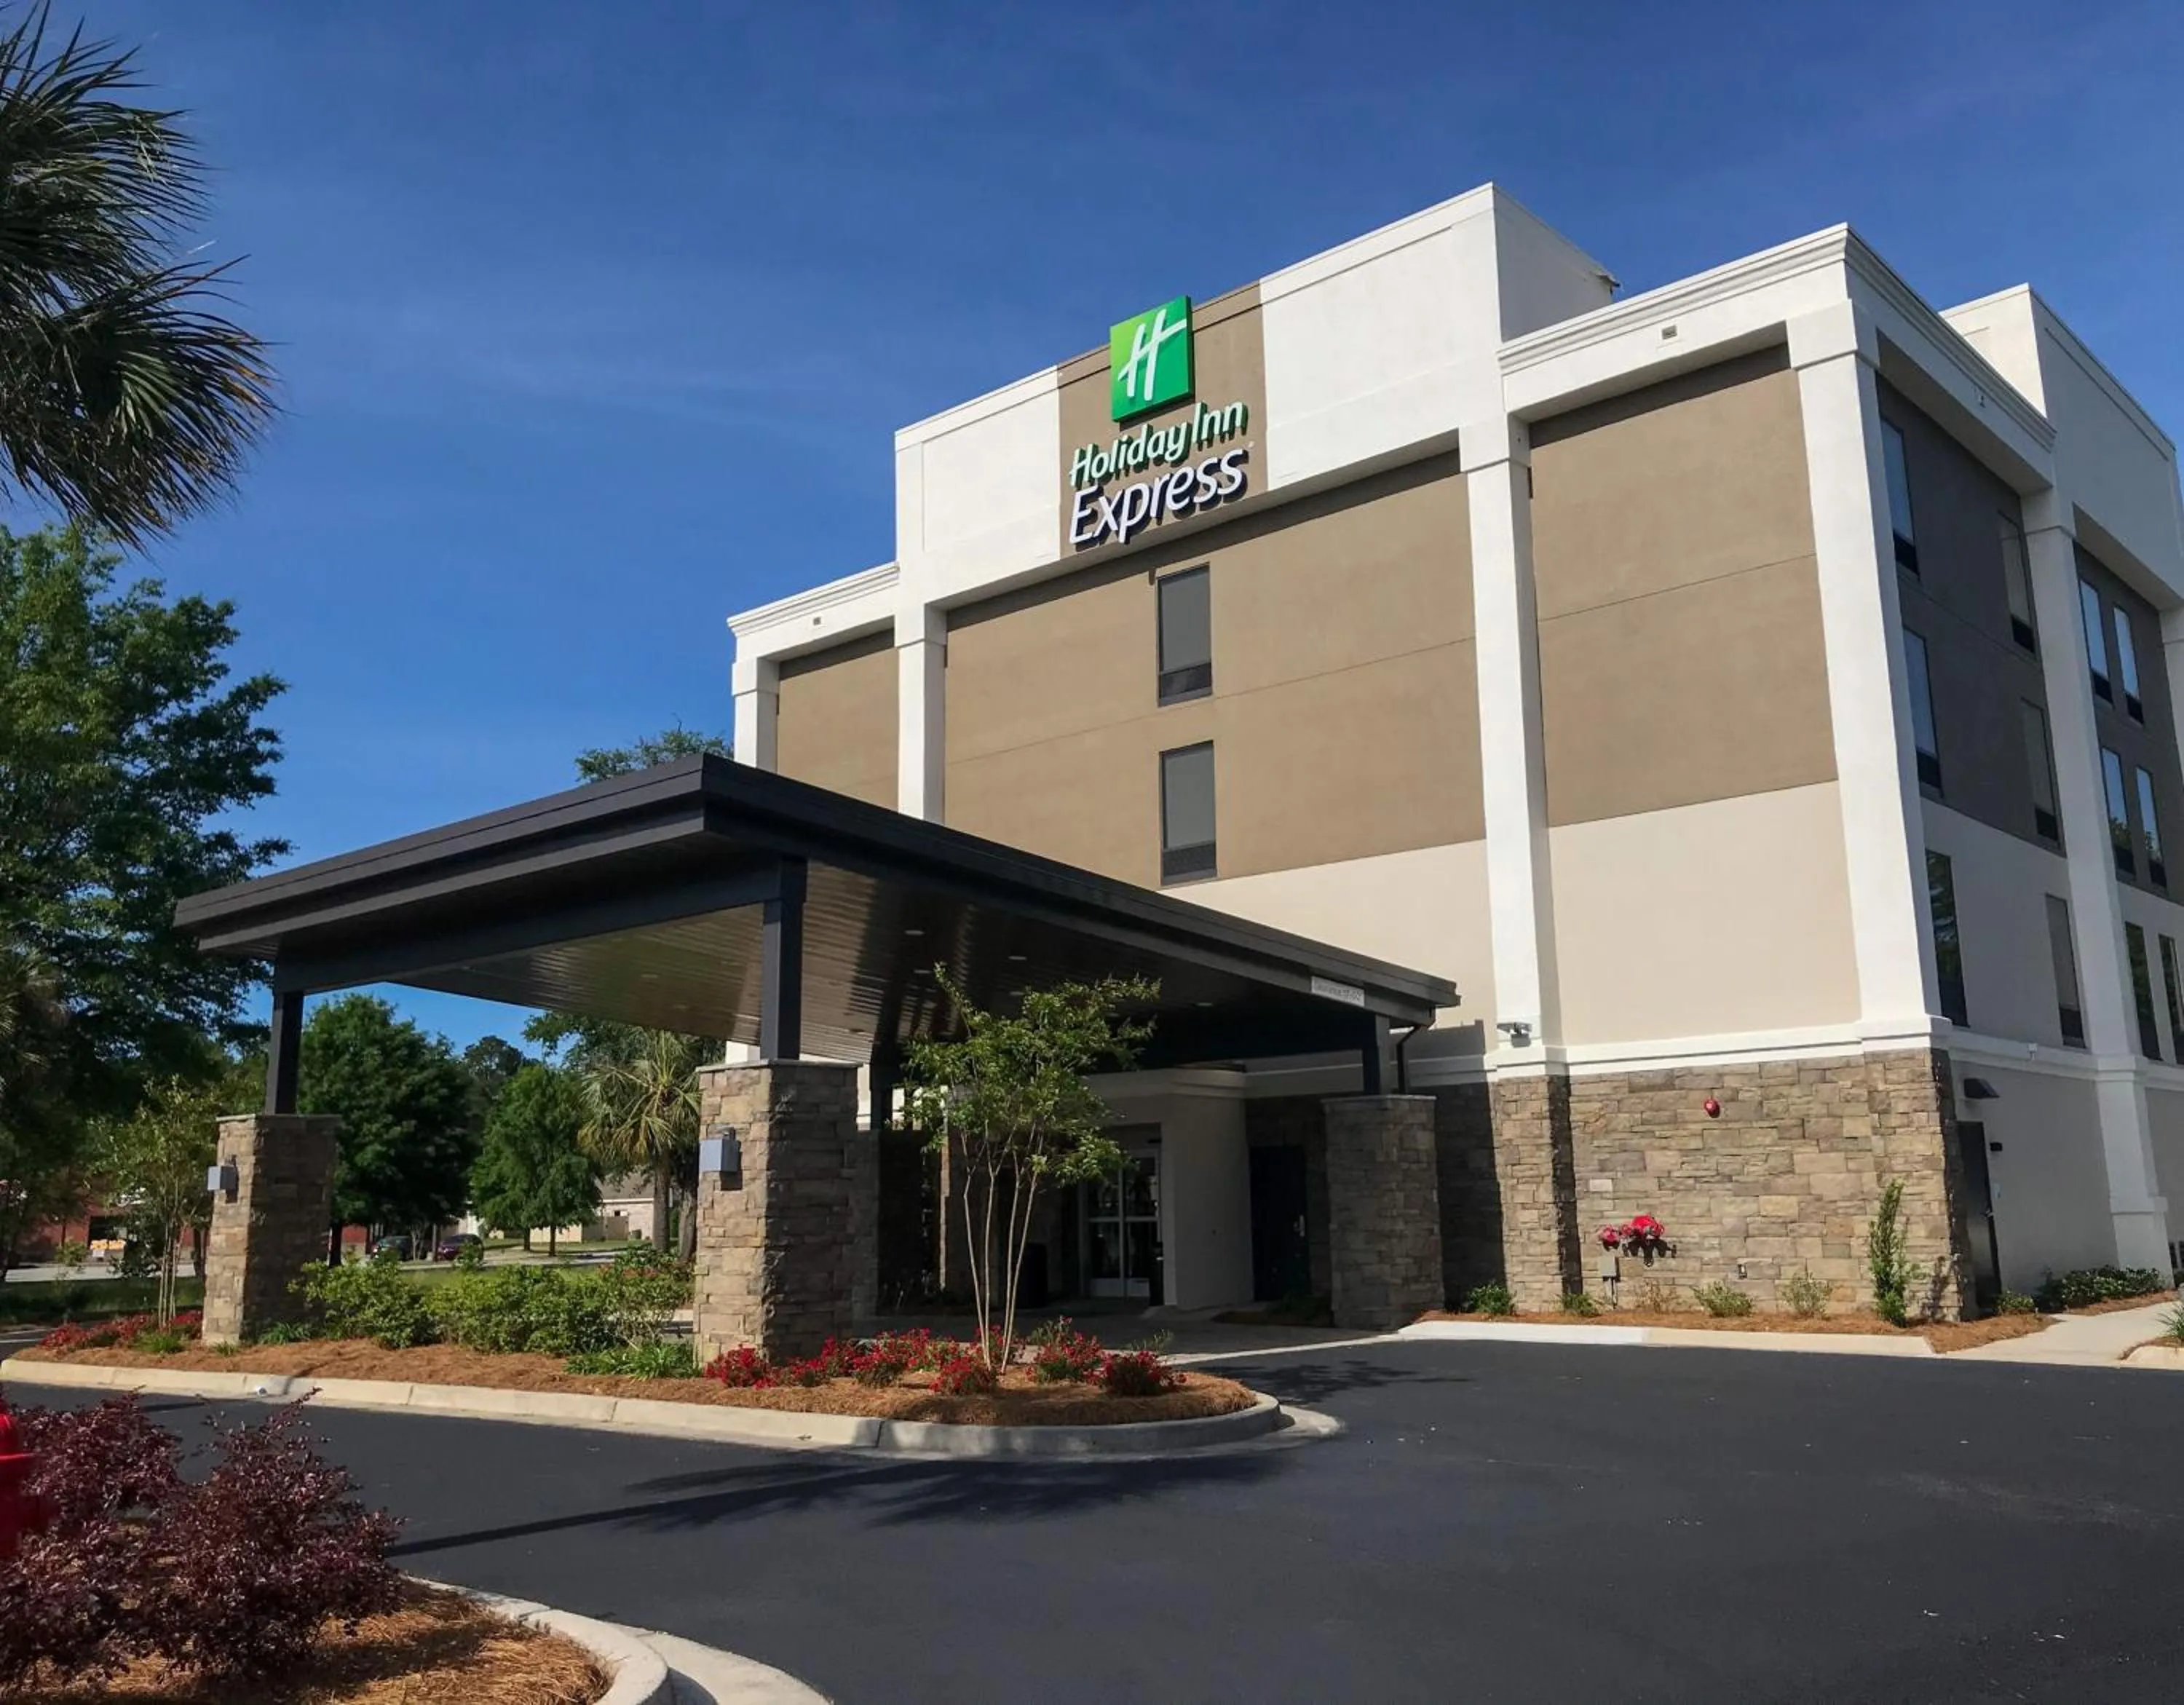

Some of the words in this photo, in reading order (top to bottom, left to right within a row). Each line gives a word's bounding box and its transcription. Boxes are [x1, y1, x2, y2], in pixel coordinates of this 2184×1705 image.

[1069, 423, 1187, 487] Holiday
[1192, 401, 1243, 443] Inn
[1069, 448, 1243, 544] Express
